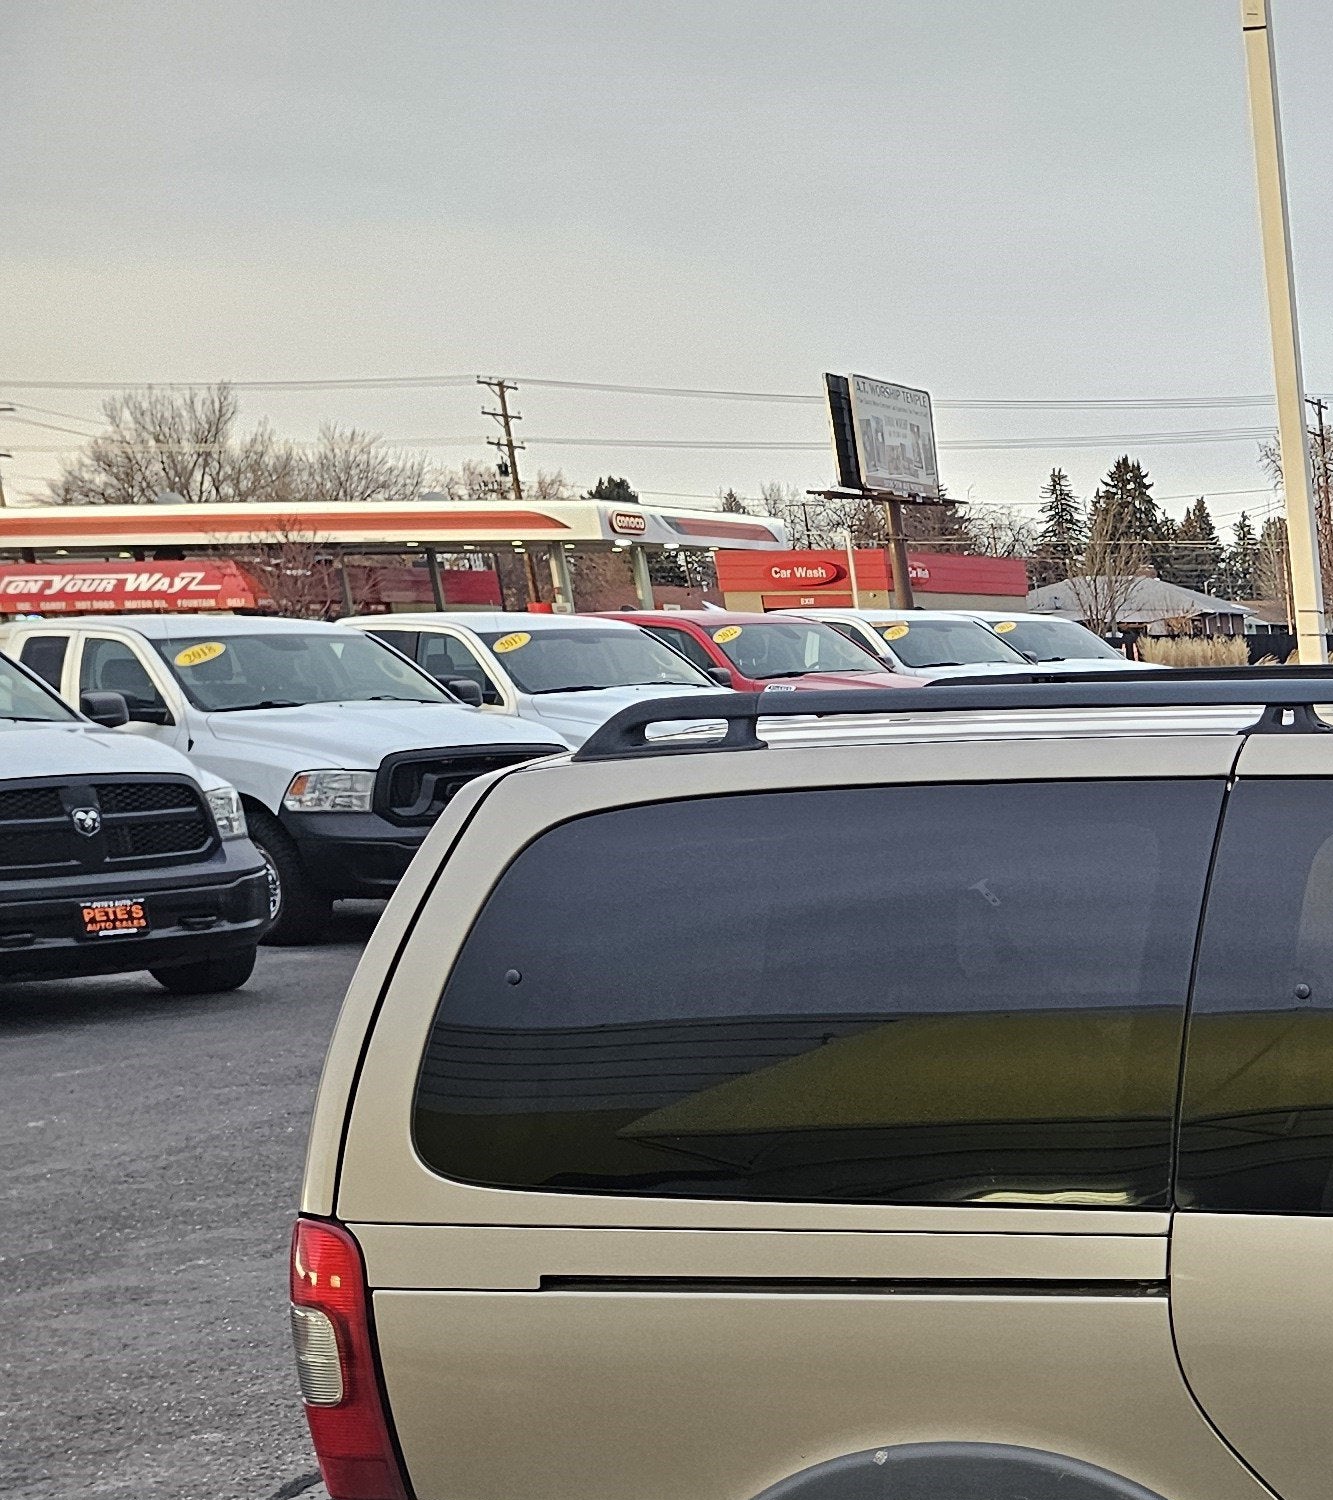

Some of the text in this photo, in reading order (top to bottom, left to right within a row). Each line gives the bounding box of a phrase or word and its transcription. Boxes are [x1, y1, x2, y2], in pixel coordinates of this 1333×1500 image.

[902, 391, 927, 407] TEMPLE
[771, 566, 827, 578] Car Wash
[5, 580, 44, 594] ON
[82, 904, 144, 923] PETE'S
[86, 921, 113, 932] AUTO
[115, 918, 147, 928] SALES
